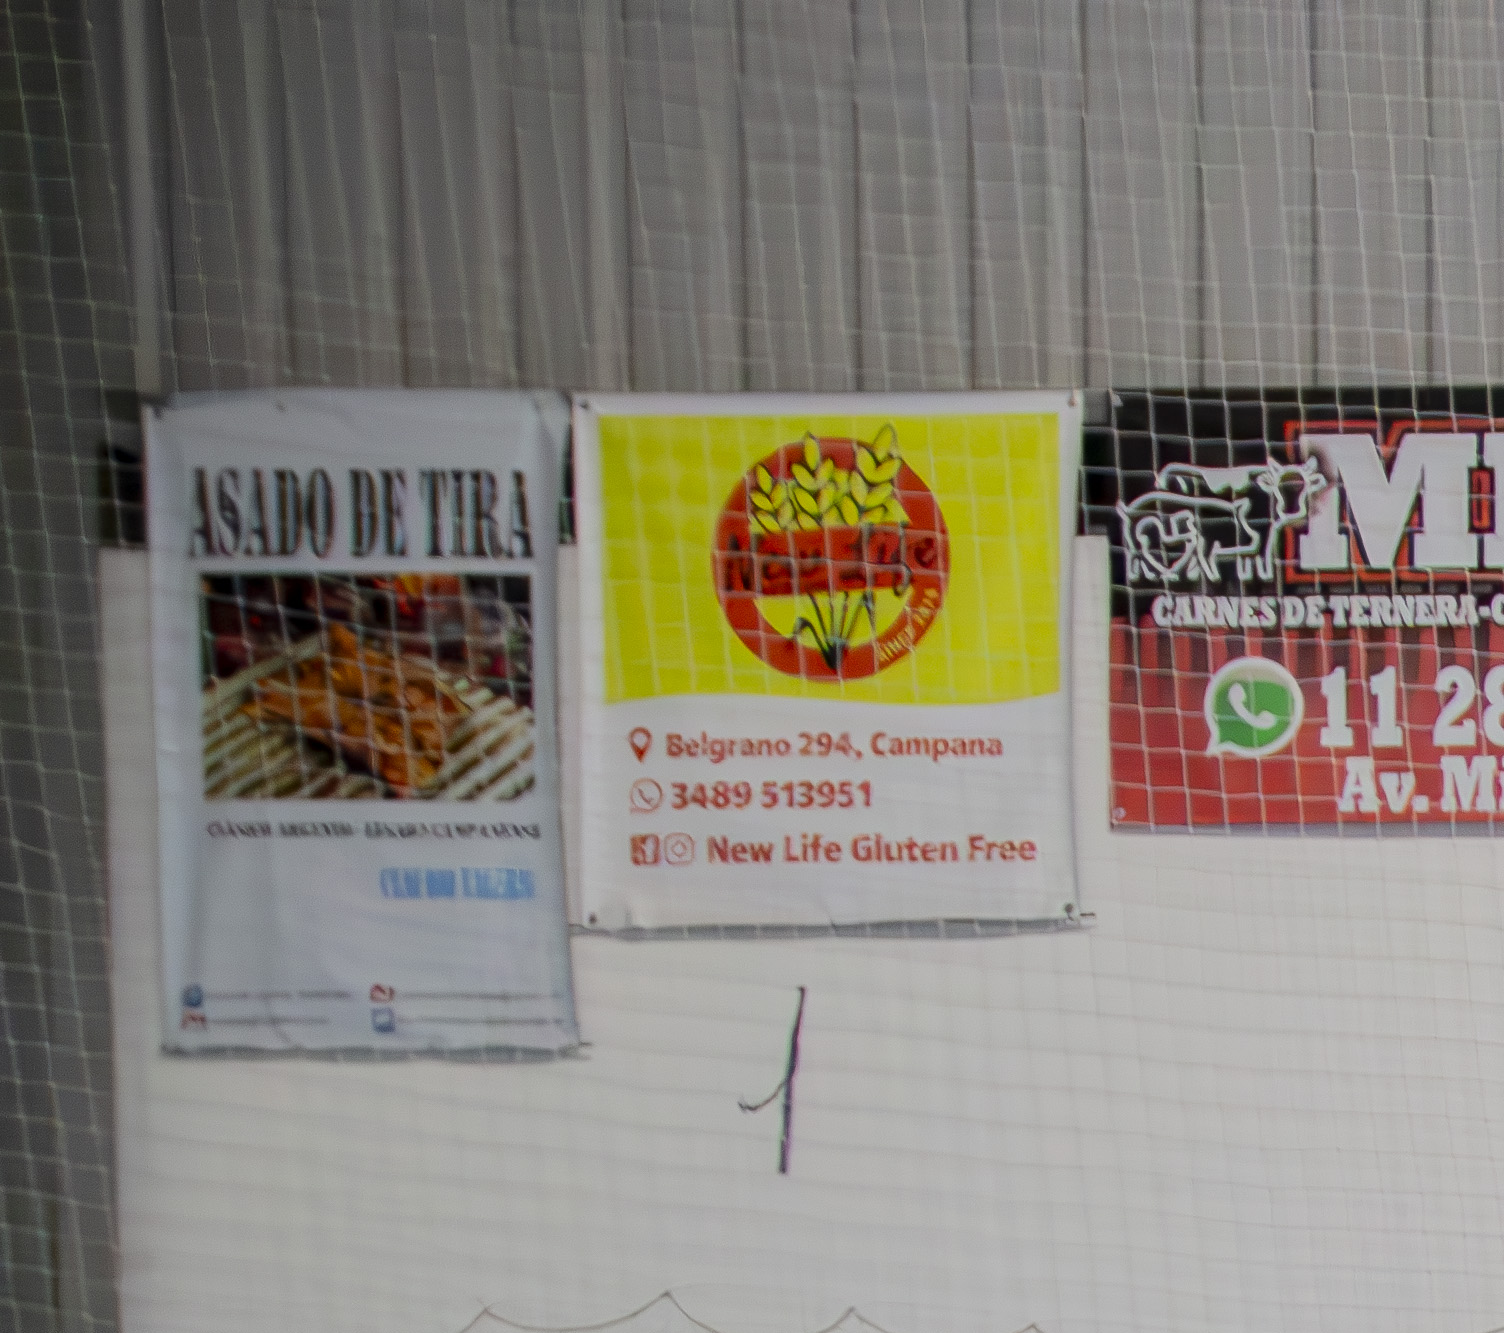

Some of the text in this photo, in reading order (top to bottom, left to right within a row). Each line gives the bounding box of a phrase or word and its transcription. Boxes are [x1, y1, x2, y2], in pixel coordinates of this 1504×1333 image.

[189, 467, 534, 559] ASADO DE TIRA
[1152, 594, 1278, 629] CARNES
[1319, 664, 1404, 748] 11
[665, 731, 1004, 764] Belgrano 294, Campana
[670, 779, 873, 810] 3489 513951
[1336, 755, 1430, 813] Av.
[706, 833, 1038, 864] New Life Gluten Free
